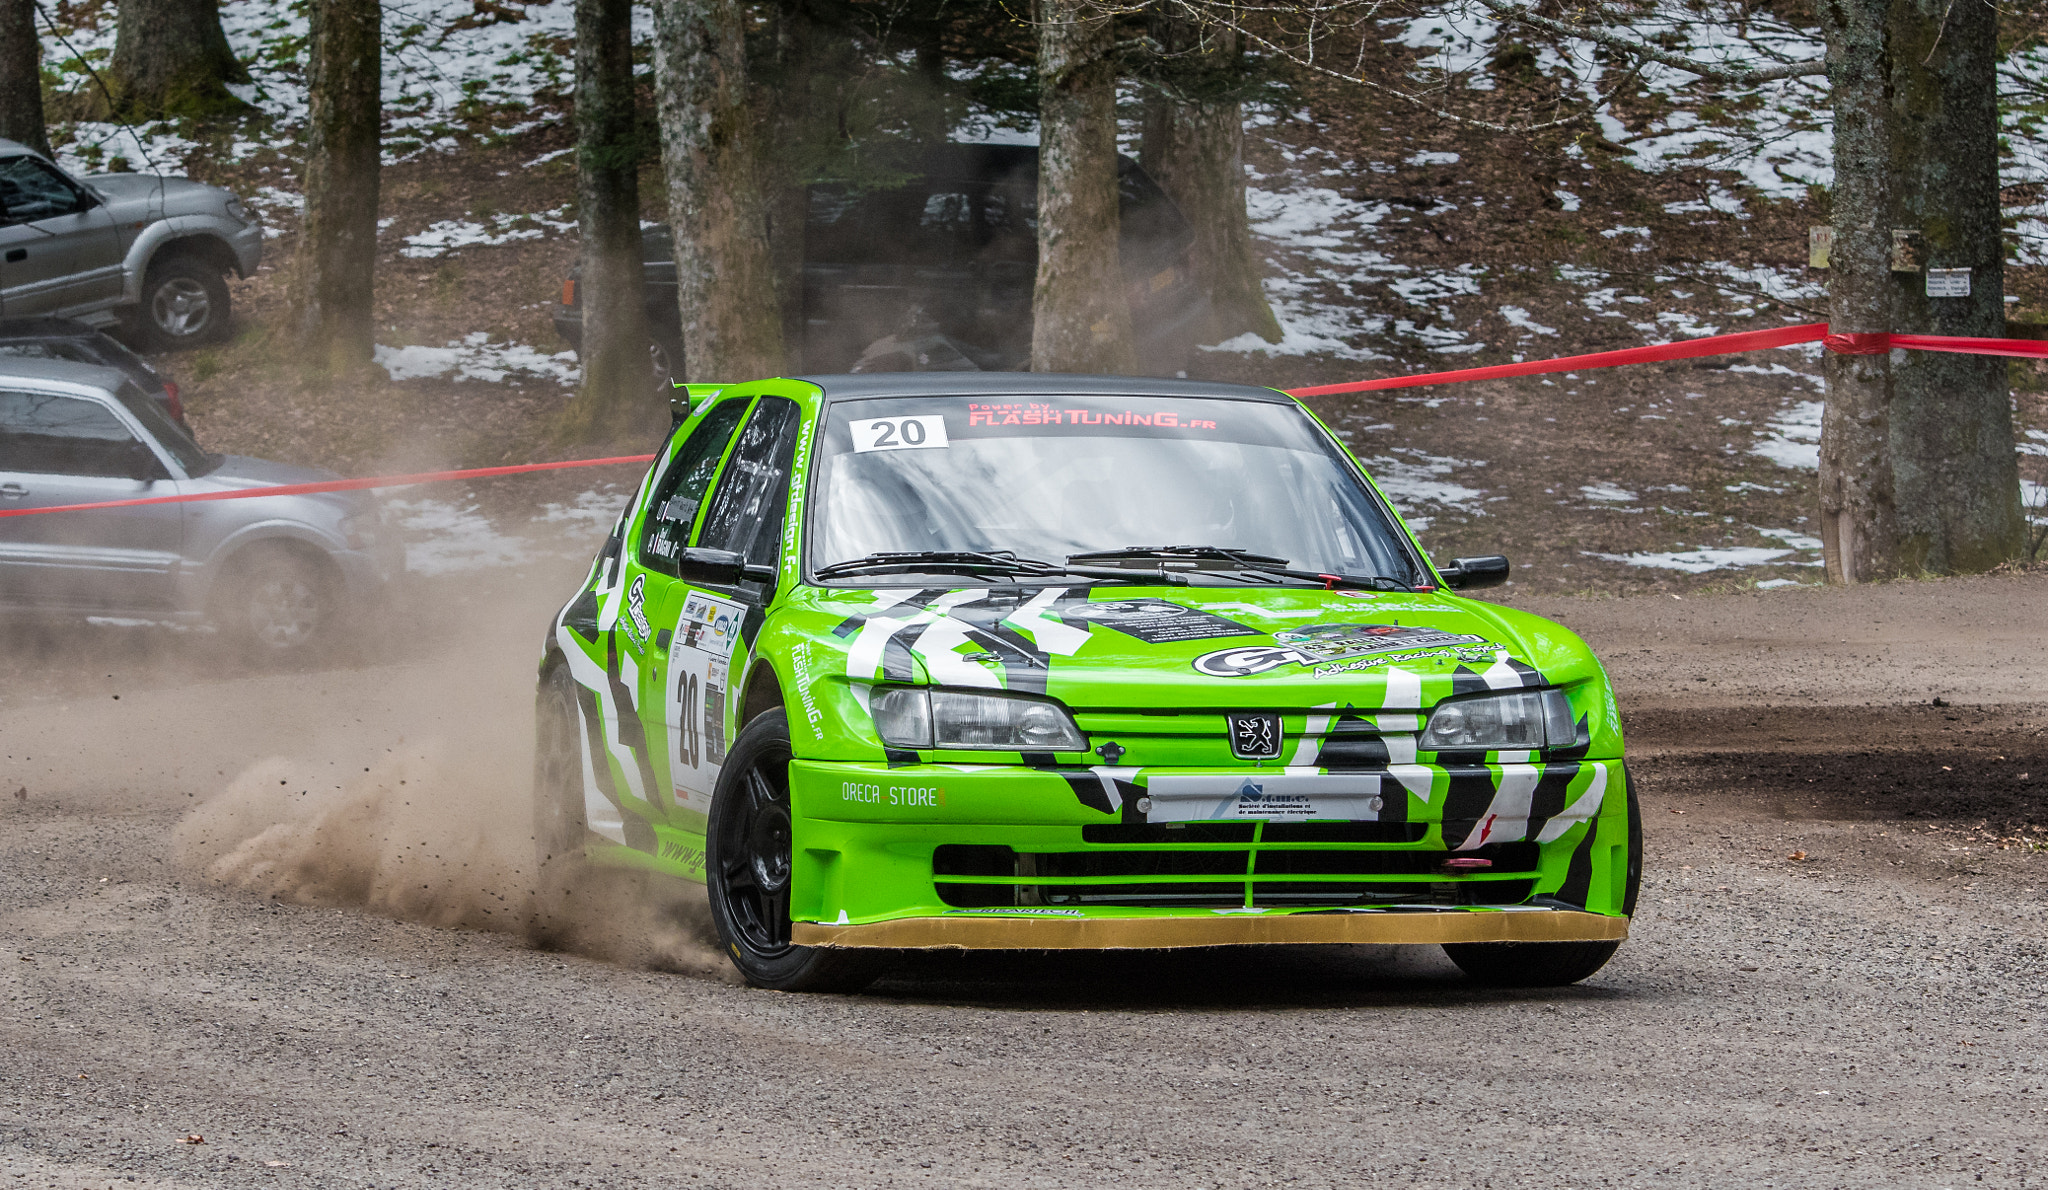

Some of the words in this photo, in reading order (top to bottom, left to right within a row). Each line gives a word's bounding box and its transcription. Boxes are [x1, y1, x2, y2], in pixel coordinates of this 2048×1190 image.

[1029, 401, 1051, 412] by
[870, 419, 927, 448] 20
[1313, 657, 1388, 680] Adhesive
[1387, 647, 1451, 663] Racing
[1449, 642, 1506, 654] Project
[677, 669, 700, 770] 20
